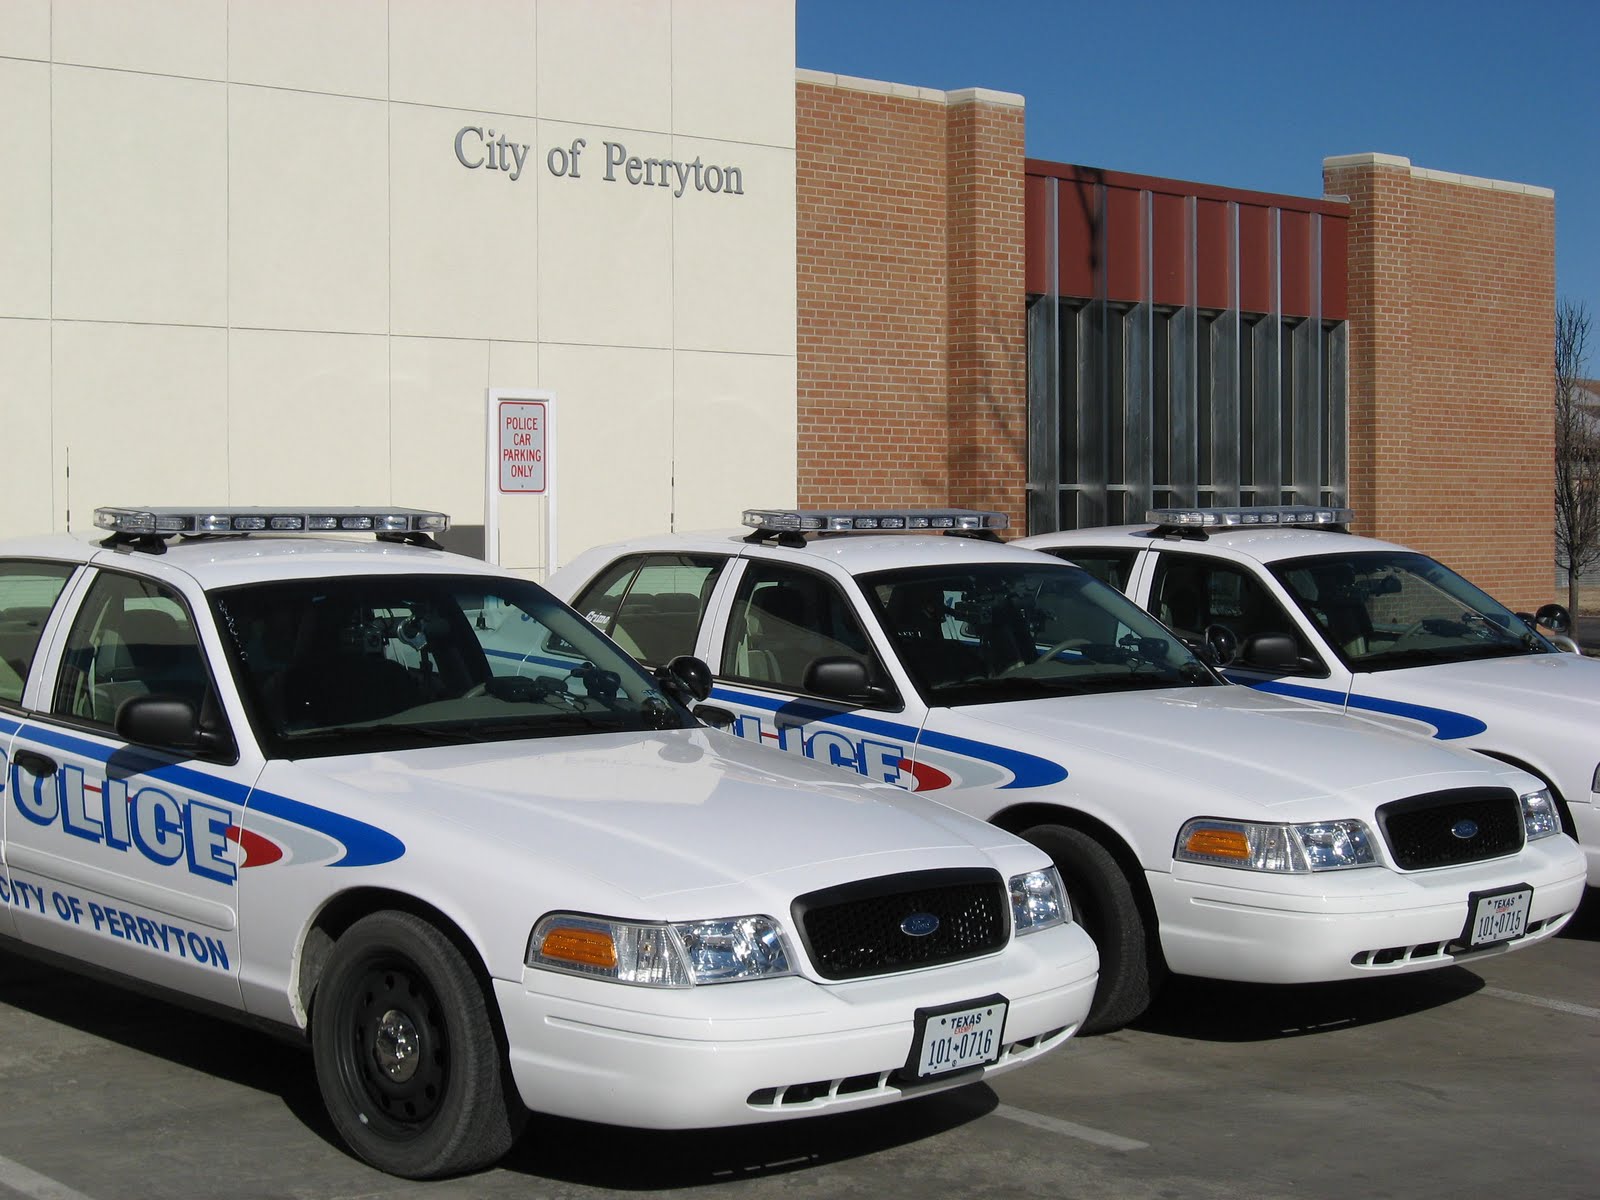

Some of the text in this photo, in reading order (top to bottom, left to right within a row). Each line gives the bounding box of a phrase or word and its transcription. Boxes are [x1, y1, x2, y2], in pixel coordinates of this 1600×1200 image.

[454, 126, 744, 198] City of Perryton
[506, 417, 538, 430] POLICE
[513, 433, 531, 446] CAR
[503, 449, 541, 462] PARKING
[511, 465, 533, 477] ONLY
[0, 747, 237, 886] OLICE
[1494, 897, 1515, 909] TEXAS
[0, 875, 230, 970] CITY OF PERRYTON
[951, 1013, 982, 1029] TEXAS
